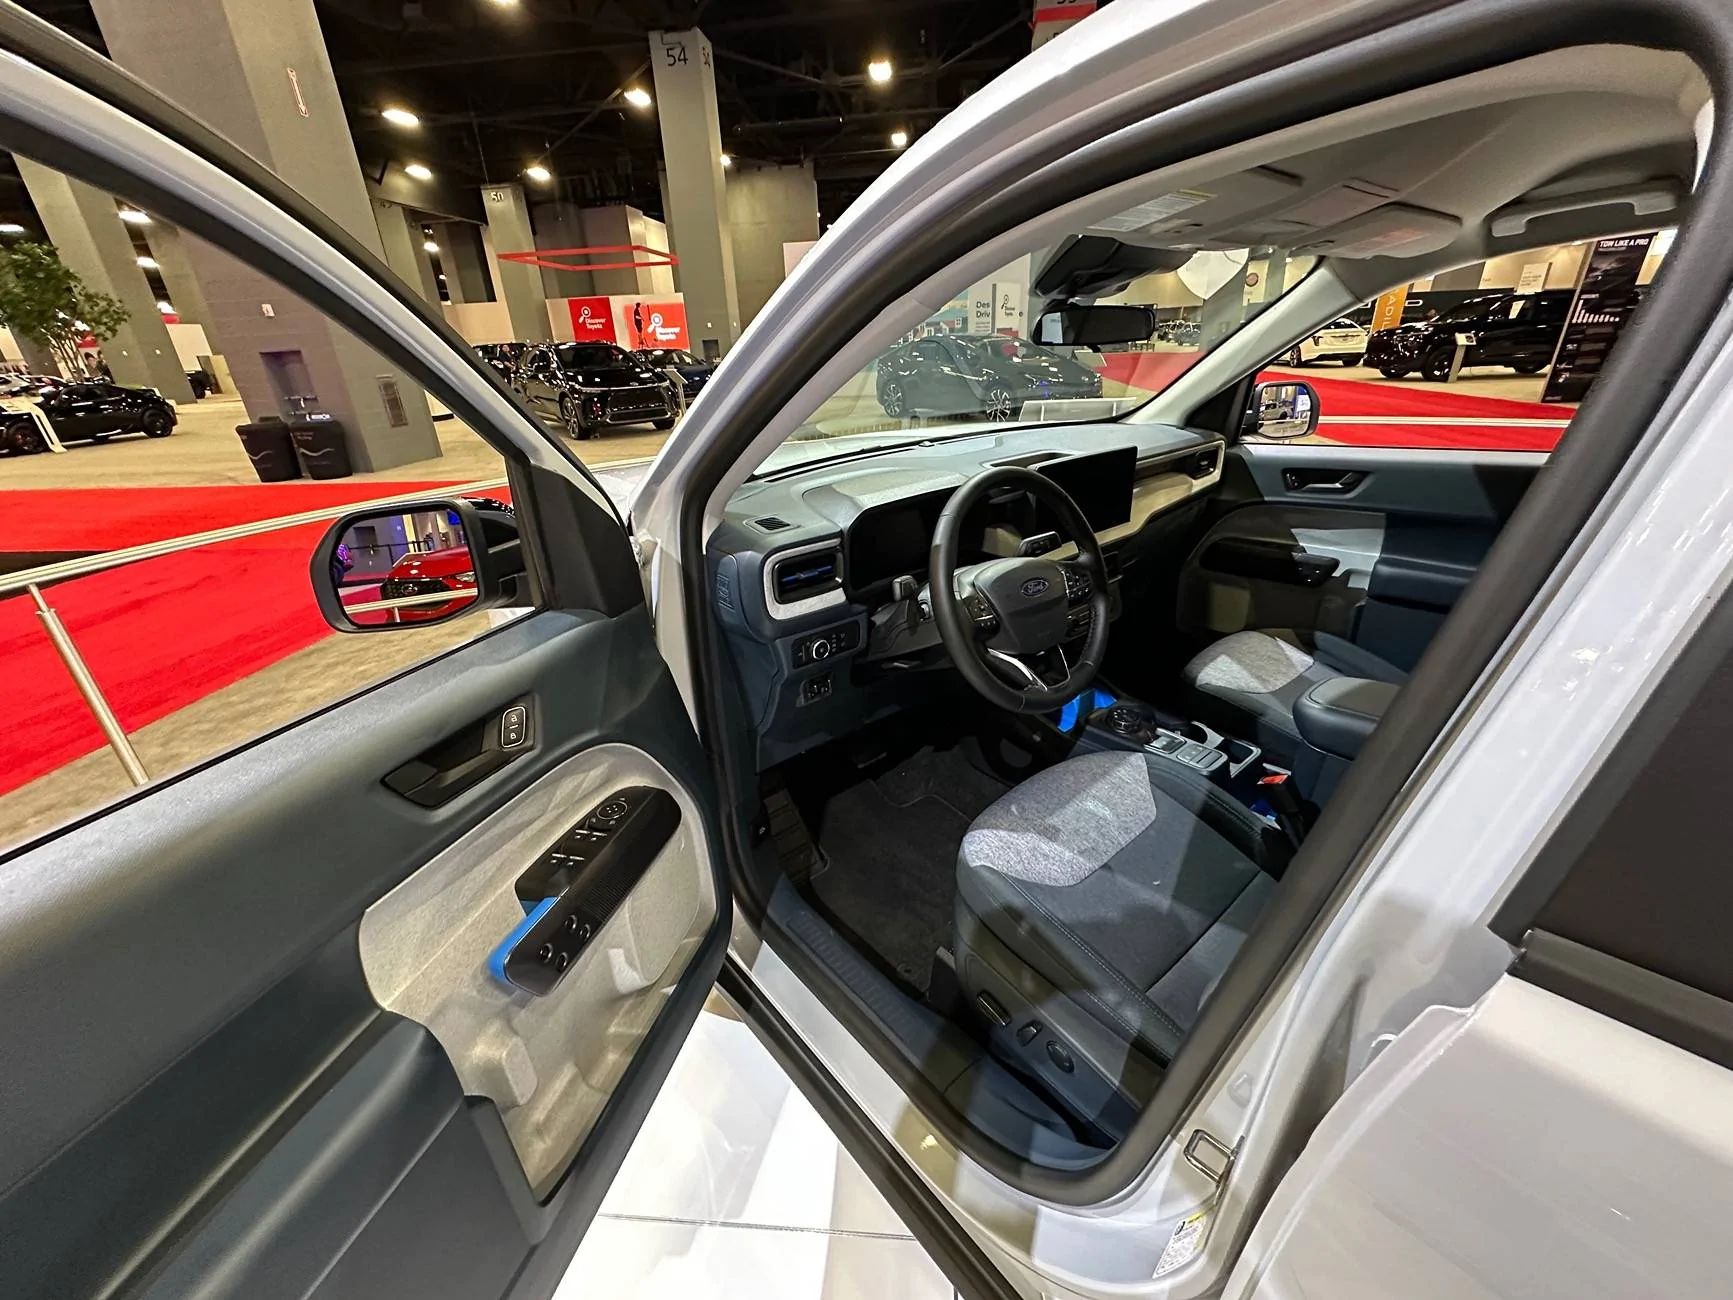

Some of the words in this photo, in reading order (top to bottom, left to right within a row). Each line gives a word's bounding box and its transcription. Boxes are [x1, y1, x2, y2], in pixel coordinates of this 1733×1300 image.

[666, 47, 688, 67] 54
[490, 191, 505, 203] 50
[1614, 239, 1630, 247] LIKE
[1635, 238, 1650, 246] PRO
